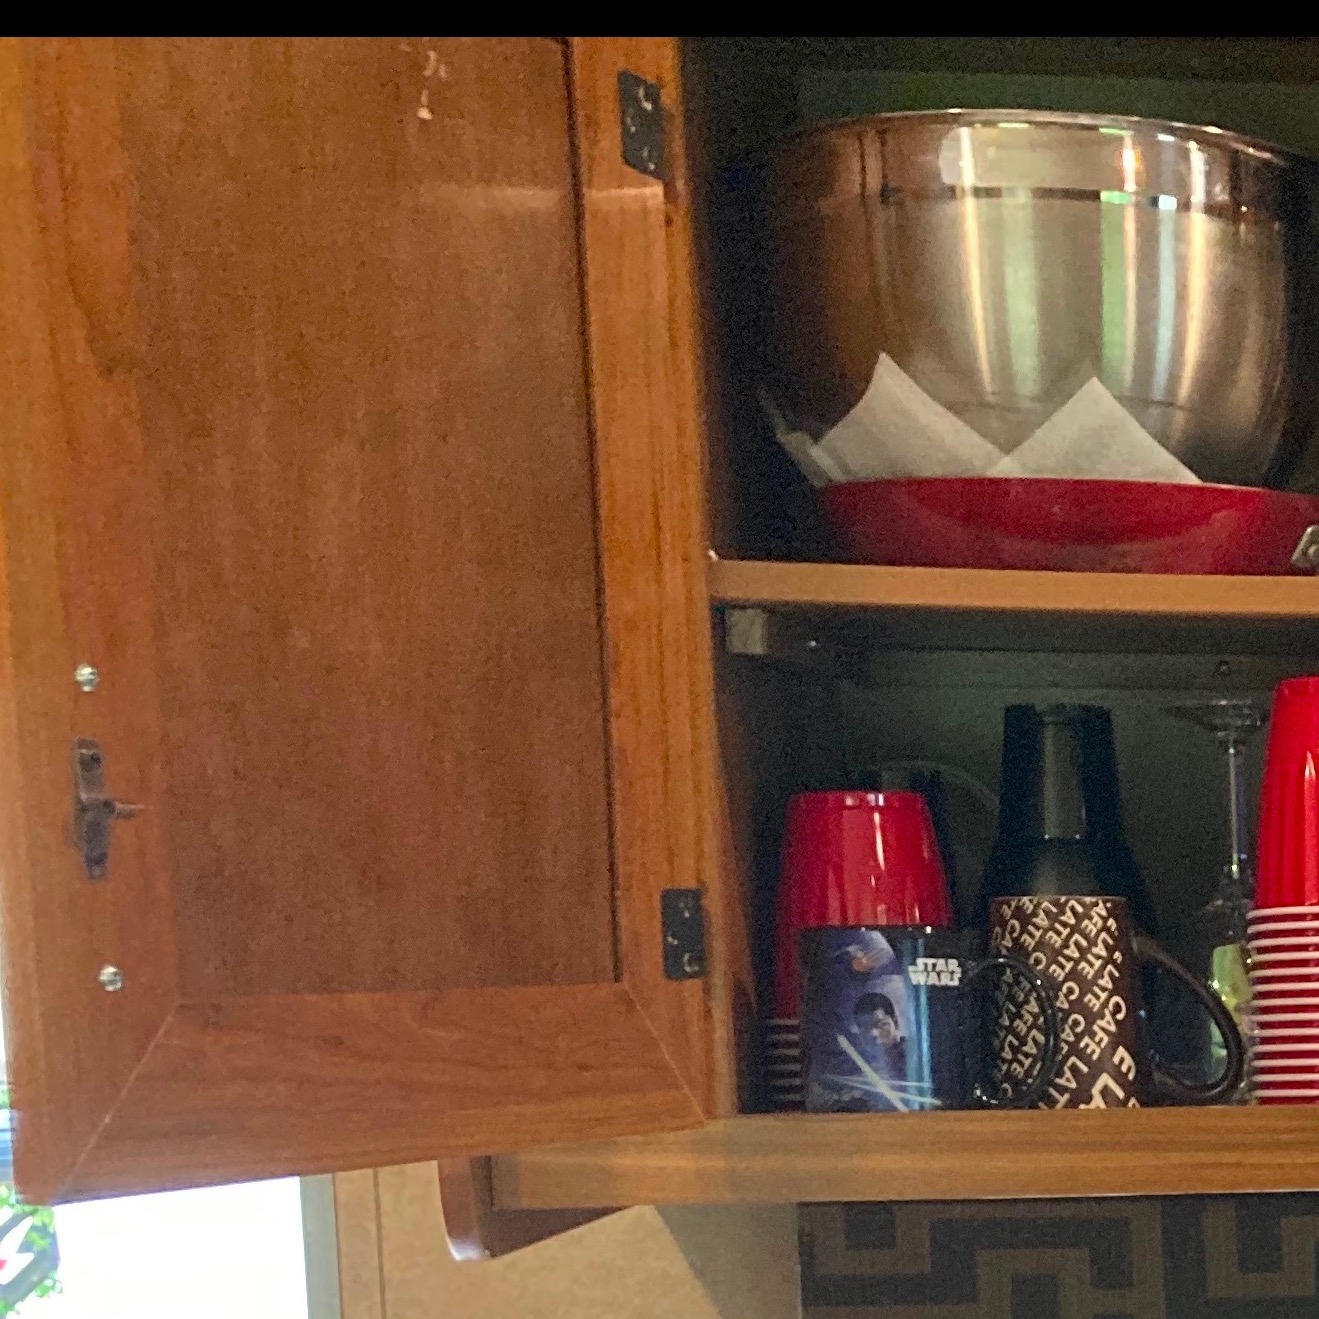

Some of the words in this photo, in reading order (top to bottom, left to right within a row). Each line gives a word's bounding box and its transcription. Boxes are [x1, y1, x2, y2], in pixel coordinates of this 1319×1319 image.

[1045, 900, 1084, 948] LATE
[908, 957, 961, 972] STAR
[909, 971, 961, 986] WARS
[1049, 933, 1088, 981] LATE
[1078, 932, 1114, 979] LATE
[1083, 964, 1120, 1012] LATE
[1080, 996, 1127, 1061] CAFE
[1011, 1029, 1045, 1079] LATE
